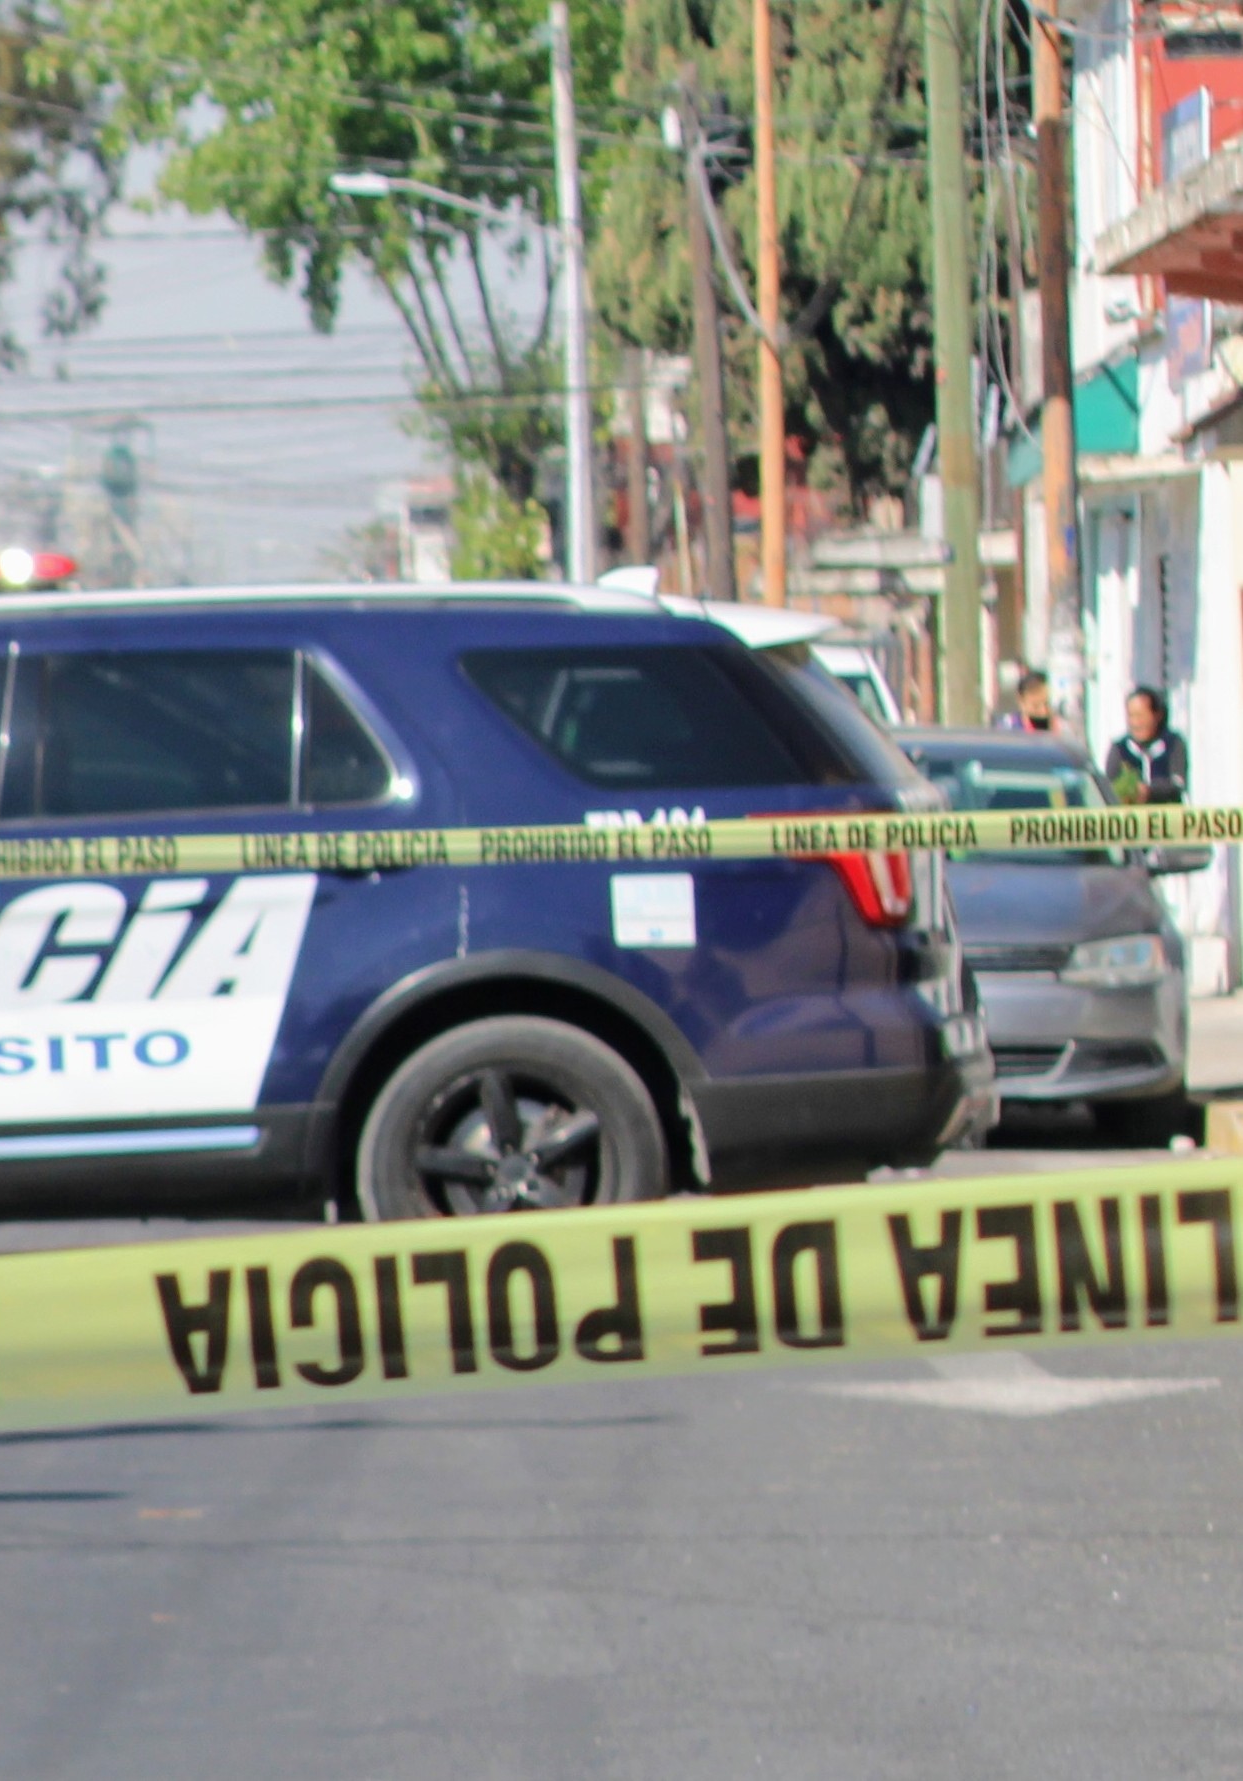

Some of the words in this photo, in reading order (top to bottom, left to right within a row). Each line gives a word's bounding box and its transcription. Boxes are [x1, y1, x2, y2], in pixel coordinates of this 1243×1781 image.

[82, 837, 109, 872] EL
[118, 835, 178, 871] PASO
[241, 834, 309, 868] LINEA
[317, 832, 347, 868] DE
[358, 829, 449, 867] POLICIA
[481, 828, 608, 863] PROHIBIDO
[618, 830, 642, 861] EL
[653, 827, 712, 860] PASO
[771, 822, 839, 852] LINEA
[847, 820, 875, 850] DE
[885, 817, 978, 848] POLICIA
[1010, 812, 1139, 844] PROHIBIDO
[1148, 811, 1173, 840] EL
[1182, 808, 1242, 839] PASO
[155, 1237, 645, 1396] POLICIA
[691, 1221, 846, 1356] DE
[887, 1187, 1239, 1341] LINEA
